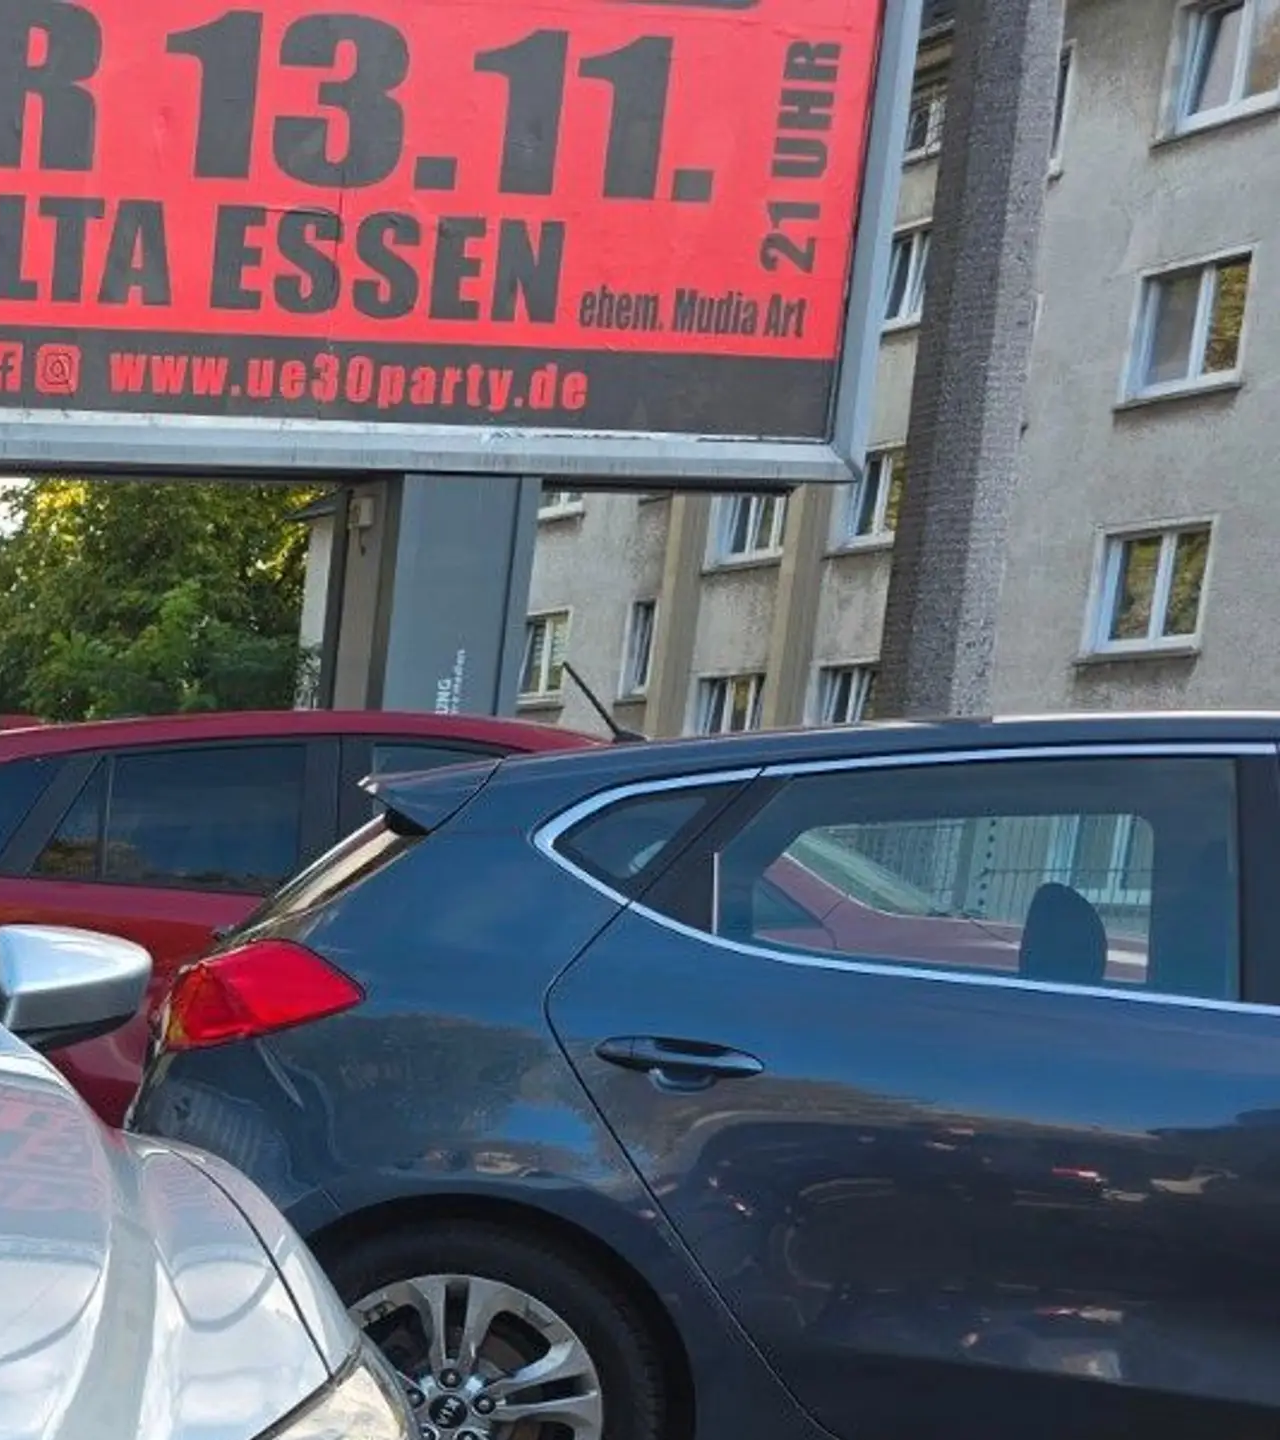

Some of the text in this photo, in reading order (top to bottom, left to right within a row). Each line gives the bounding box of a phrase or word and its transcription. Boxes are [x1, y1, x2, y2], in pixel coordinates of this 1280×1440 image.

[165, 10, 714, 203] 13.11.
[759, 40, 842, 273] 21 UHR
[209, 204, 566, 324] ESSEN
[578, 284, 807, 338] ehem. Mudia Art
[109, 350, 588, 411] www.ue30party.de
